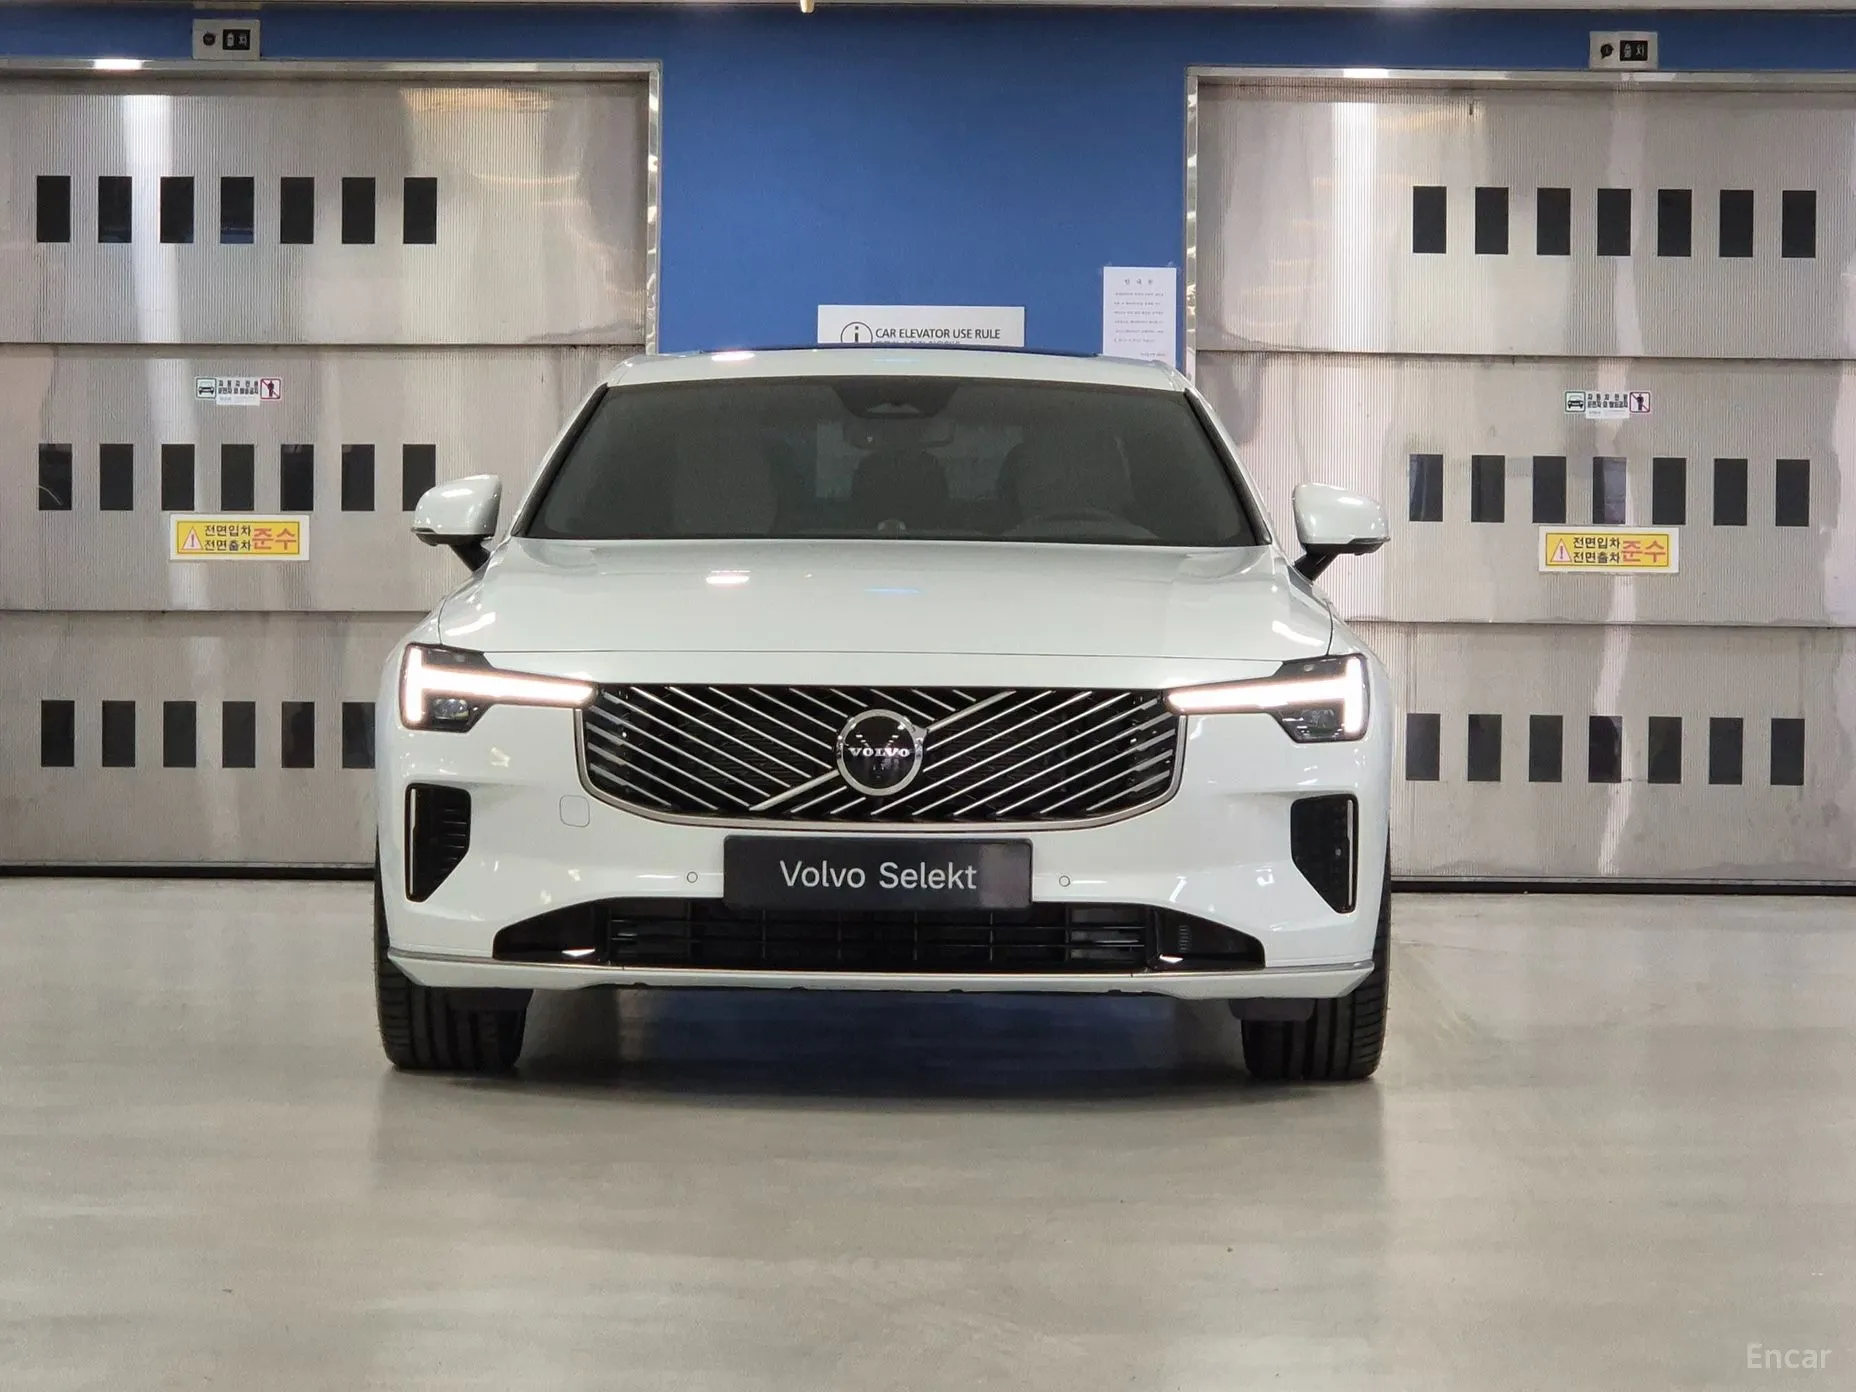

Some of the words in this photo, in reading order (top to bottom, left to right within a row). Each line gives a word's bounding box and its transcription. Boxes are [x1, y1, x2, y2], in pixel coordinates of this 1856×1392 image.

[875, 328, 896, 339] CAR
[899, 328, 951, 339] ELEVATOR
[953, 329, 972, 340] USE
[975, 329, 1000, 340] RULE
[205, 525, 251, 537] 전면입차
[252, 527, 297, 550] 준수
[1573, 537, 1620, 549] 전면입차
[1573, 551, 1620, 563] 전면출차
[1621, 540, 1666, 563] 준수
[848, 747, 910, 757] VOLVO
[779, 860, 866, 888] Volvo
[879, 861, 977, 889] Selekt
